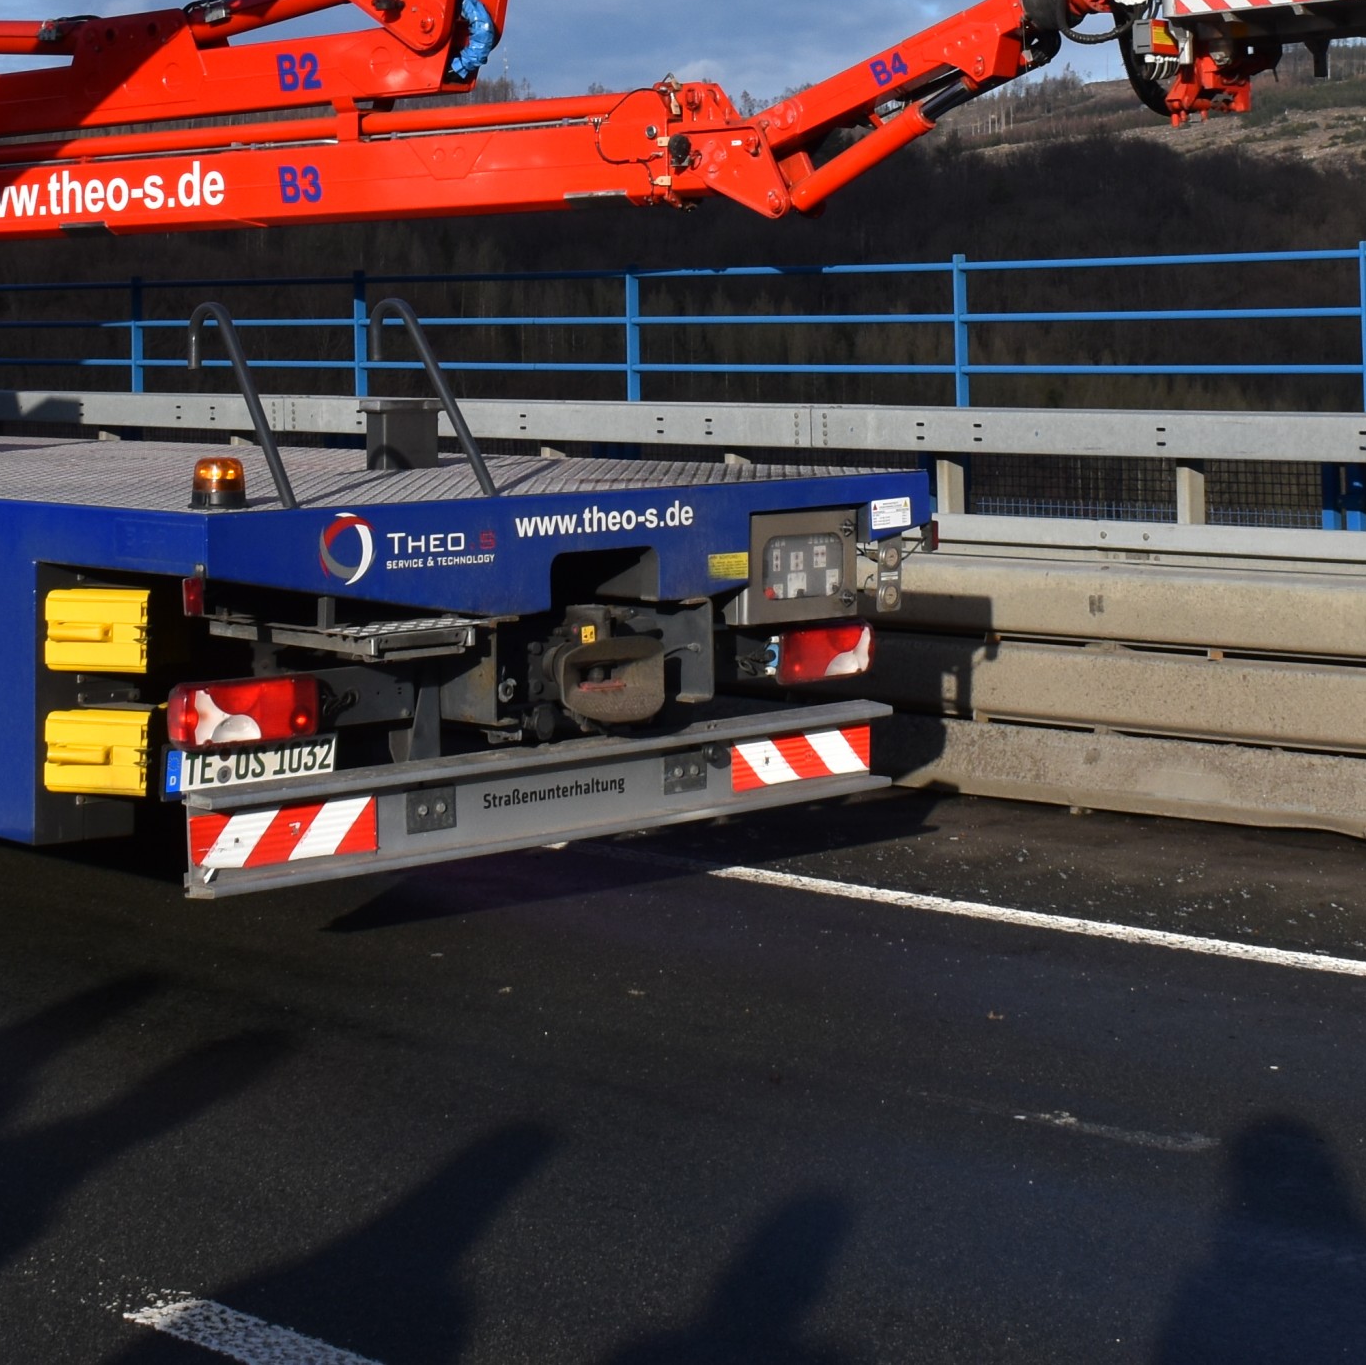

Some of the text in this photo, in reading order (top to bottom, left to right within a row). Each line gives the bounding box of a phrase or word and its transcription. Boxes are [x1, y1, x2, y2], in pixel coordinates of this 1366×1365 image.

[276, 52, 323, 91] B2
[870, 51, 909, 87] B4
[278, 165, 323, 203] B3
[515, 501, 694, 538] www.theo-s.de
[386, 553, 495, 570] SERVICE & TECHNOLOGY
[186, 752, 214, 785] TE
[273, 737, 333, 775] 1032
[169, 776, 176, 786] D
[483, 777, 625, 809] Straßenunterhaltung
